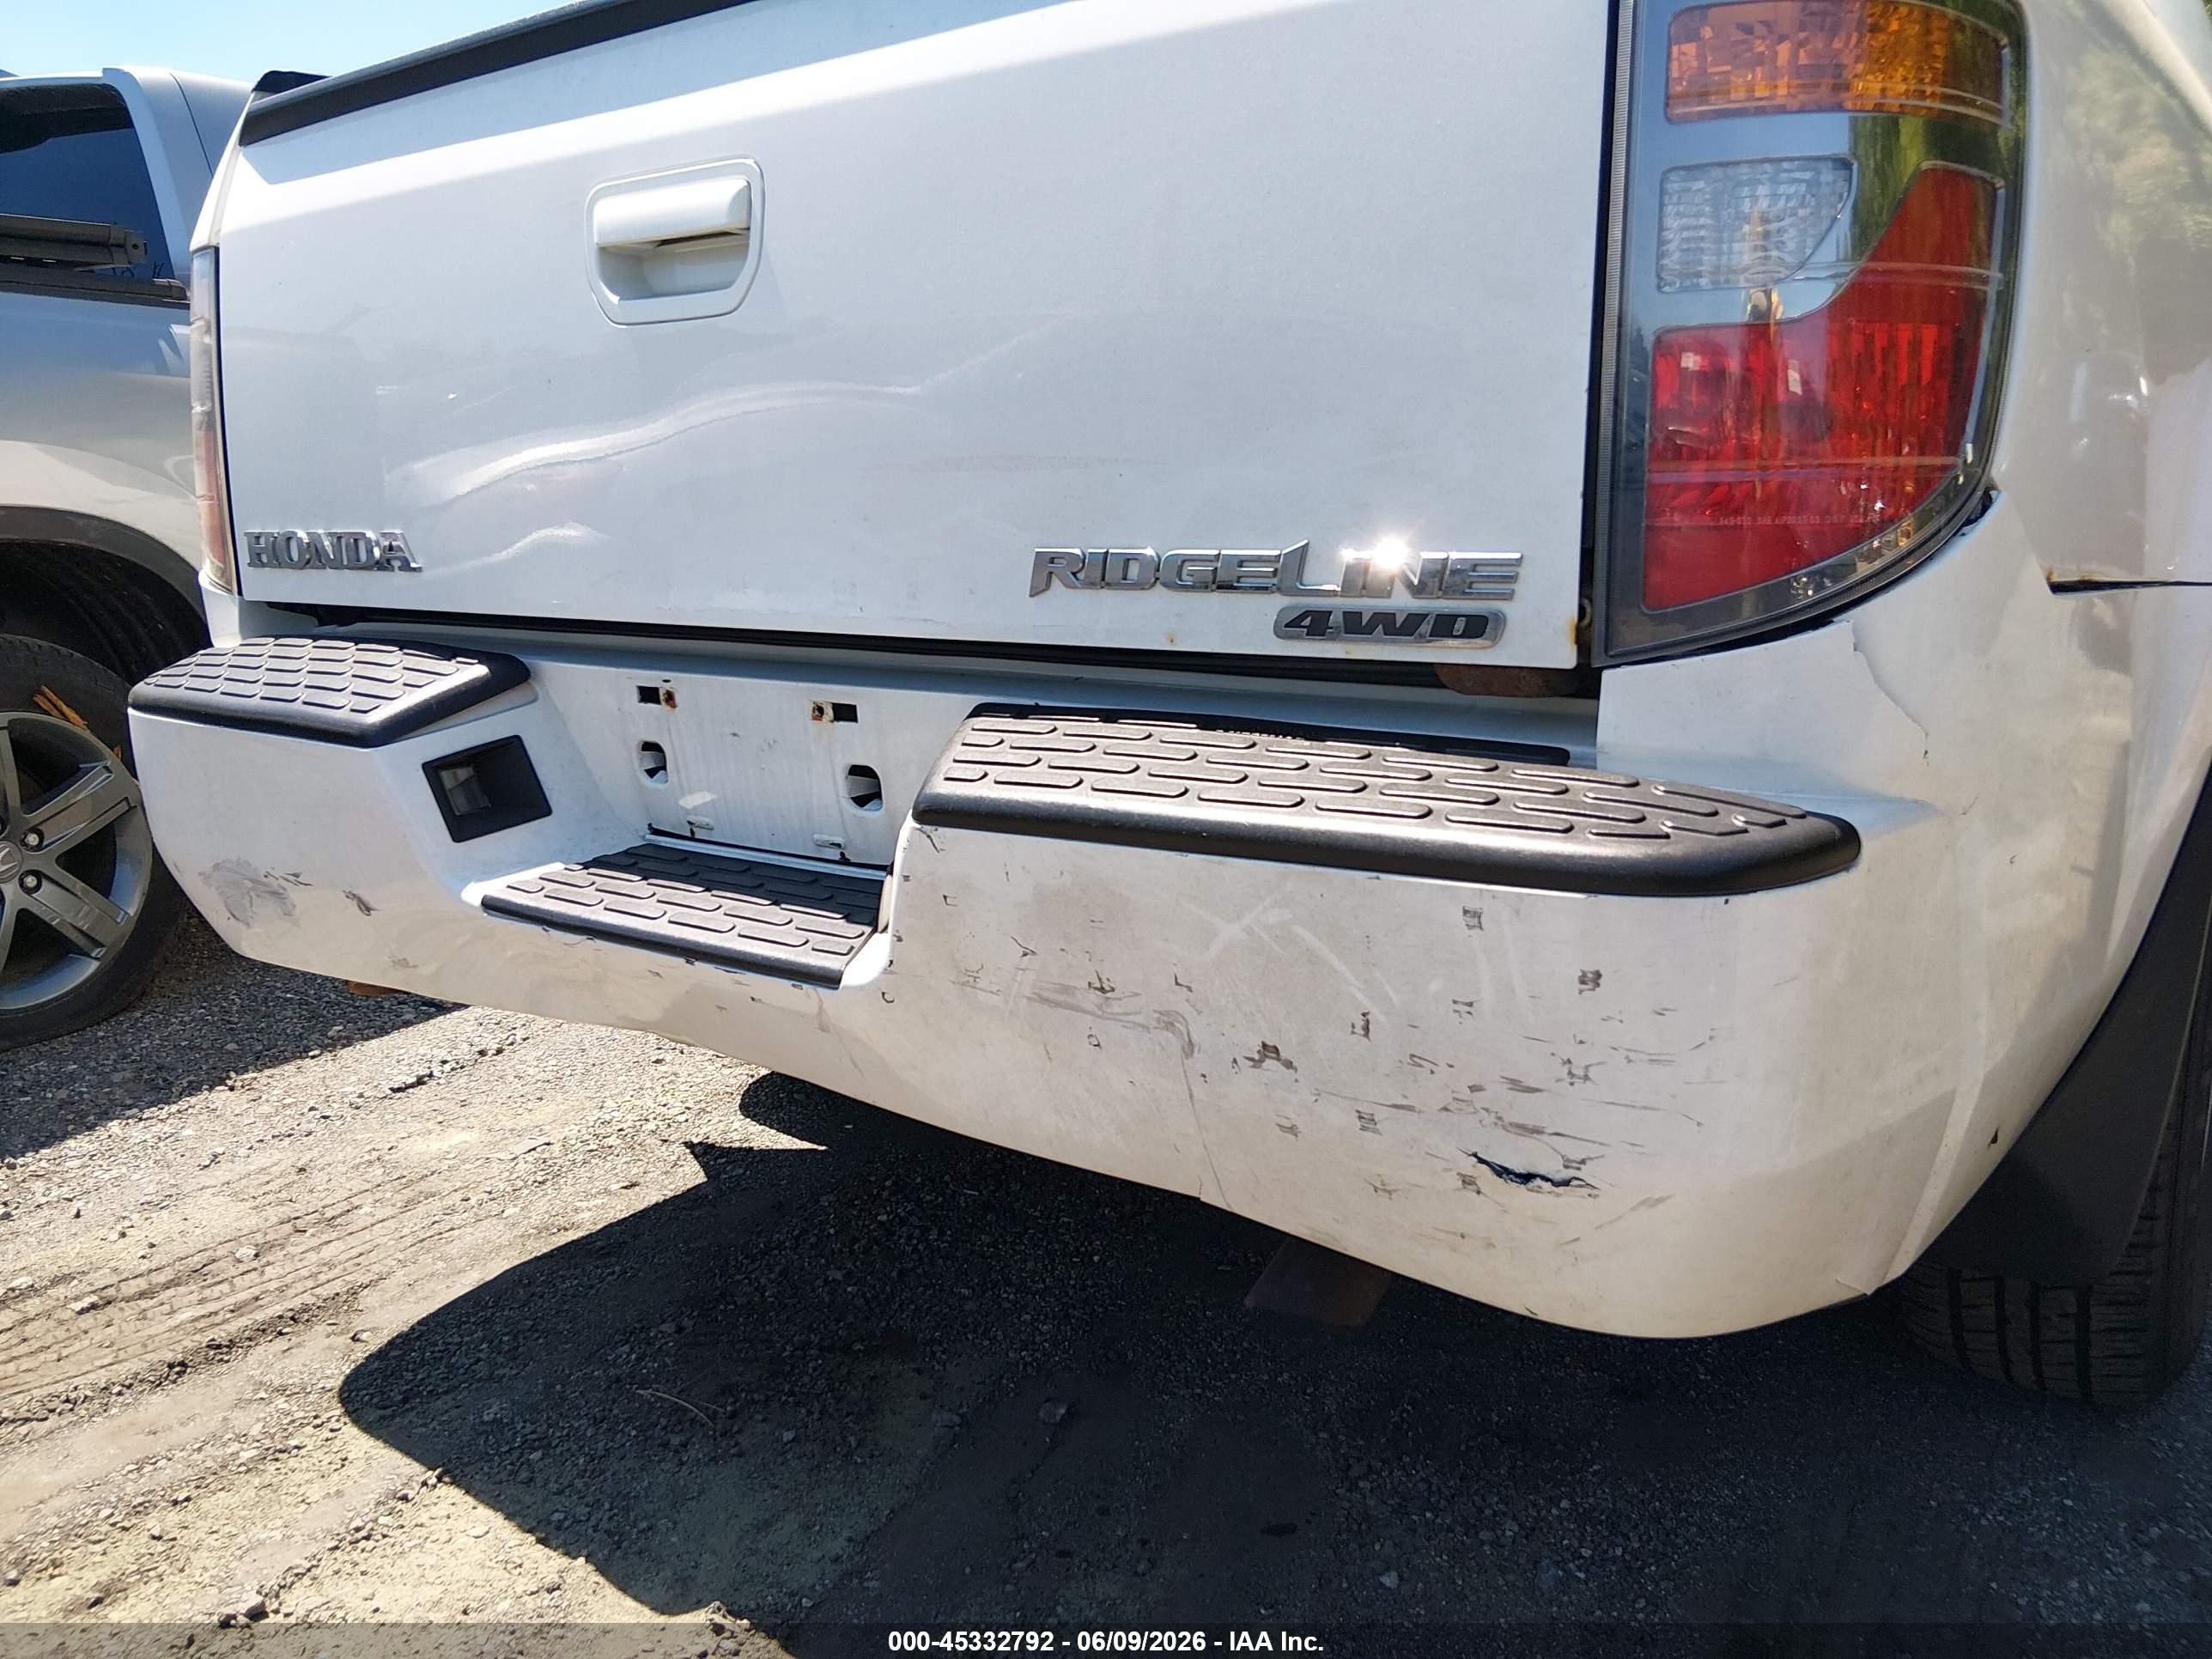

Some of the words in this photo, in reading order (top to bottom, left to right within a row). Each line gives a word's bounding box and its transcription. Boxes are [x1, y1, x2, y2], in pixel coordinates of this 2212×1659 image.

[243, 529, 422, 573] HONDA
[1029, 539, 1523, 600] RIDGELINE
[1282, 610, 1492, 640] 4WD
